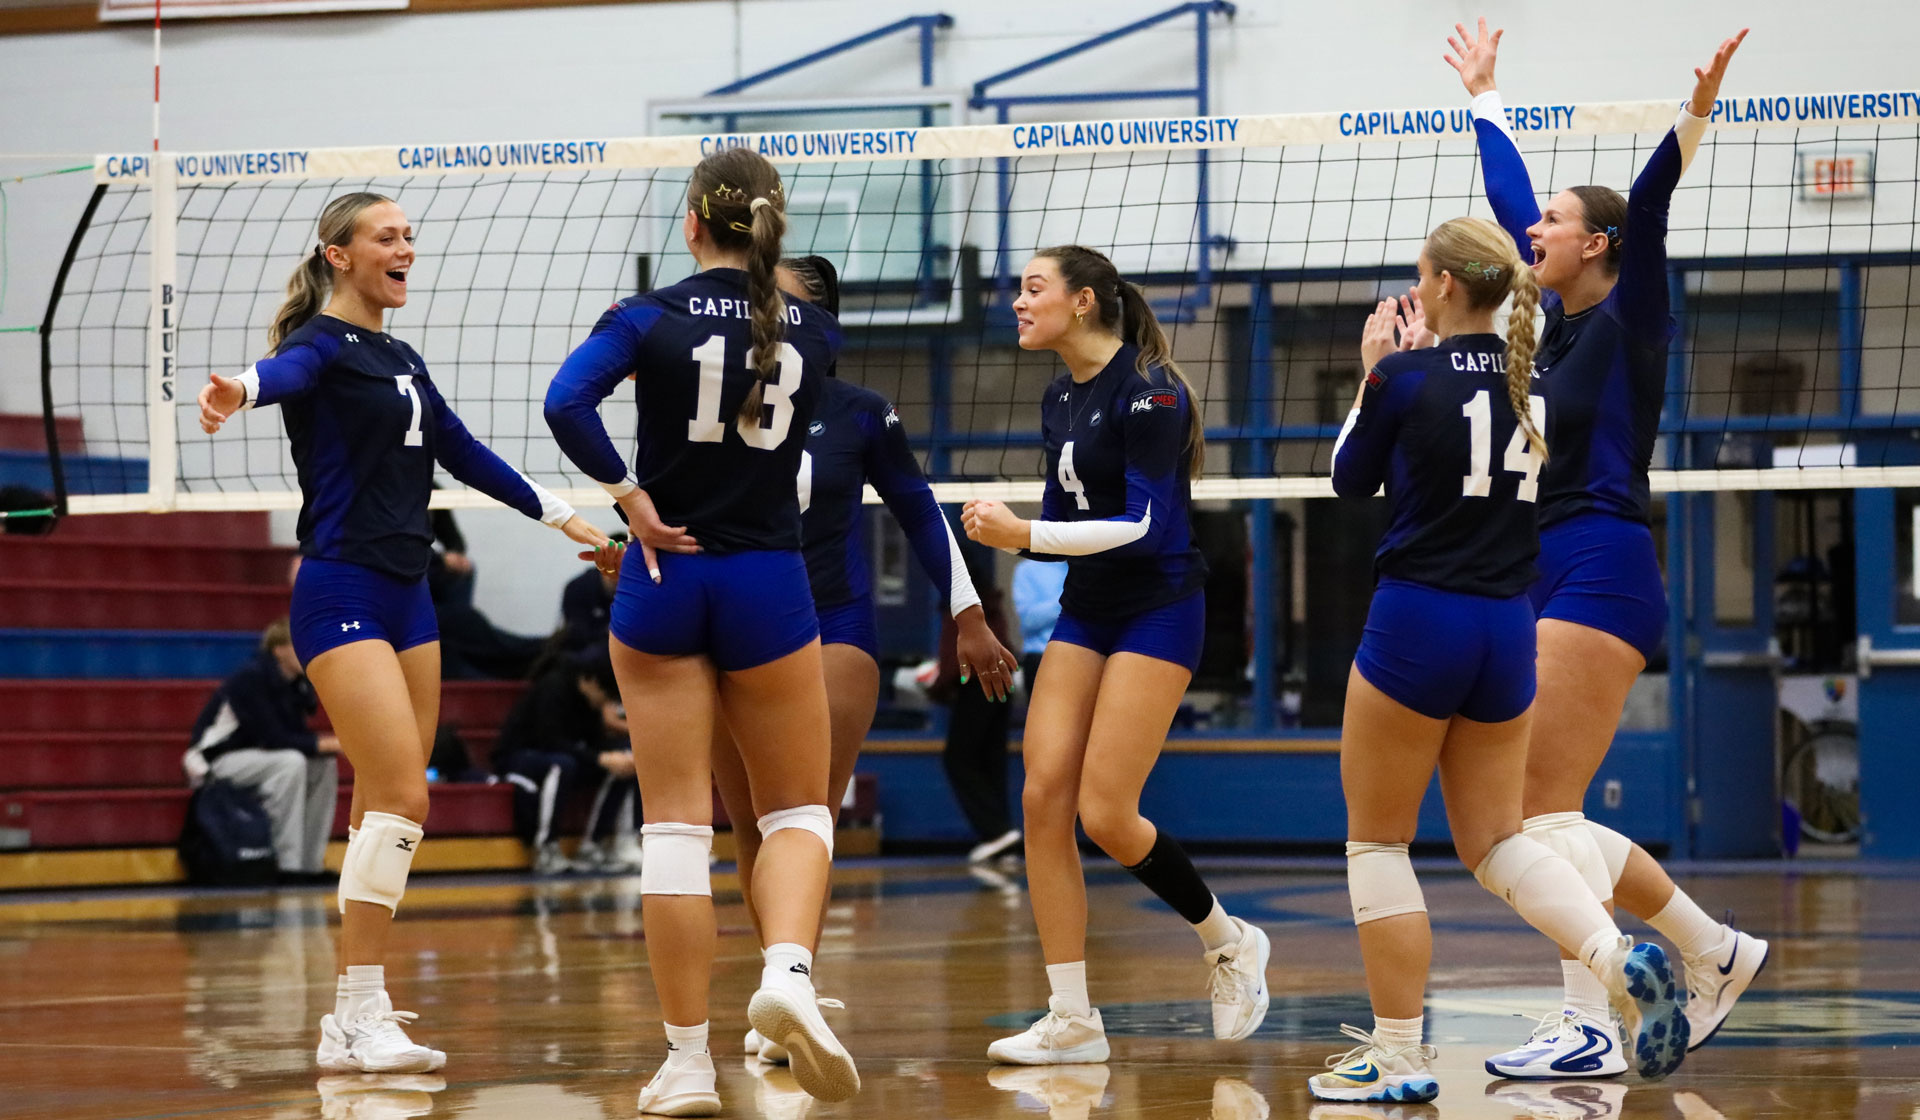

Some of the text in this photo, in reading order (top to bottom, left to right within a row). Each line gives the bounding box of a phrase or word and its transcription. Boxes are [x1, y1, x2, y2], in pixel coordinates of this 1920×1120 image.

[1339, 105, 1575, 136] CAPILANO UNRSITY
[1680, 92, 1920, 124] PILANO UNIVERSITY
[803, 130, 918, 156] UNIVERSITY
[1013, 118, 1239, 149] CAPILANO UNIVERSITY
[107, 151, 309, 178] CAPINO UNIVERSITY
[398, 141, 607, 169] CAPILANO UNIVERSITY
[689, 296, 802, 326] CAPILNO
[162, 284, 174, 402] BLUES
[688, 335, 803, 451] 13
[394, 375, 423, 446] 7
[1462, 390, 1547, 503] 14
[1058, 441, 1090, 511] 4
